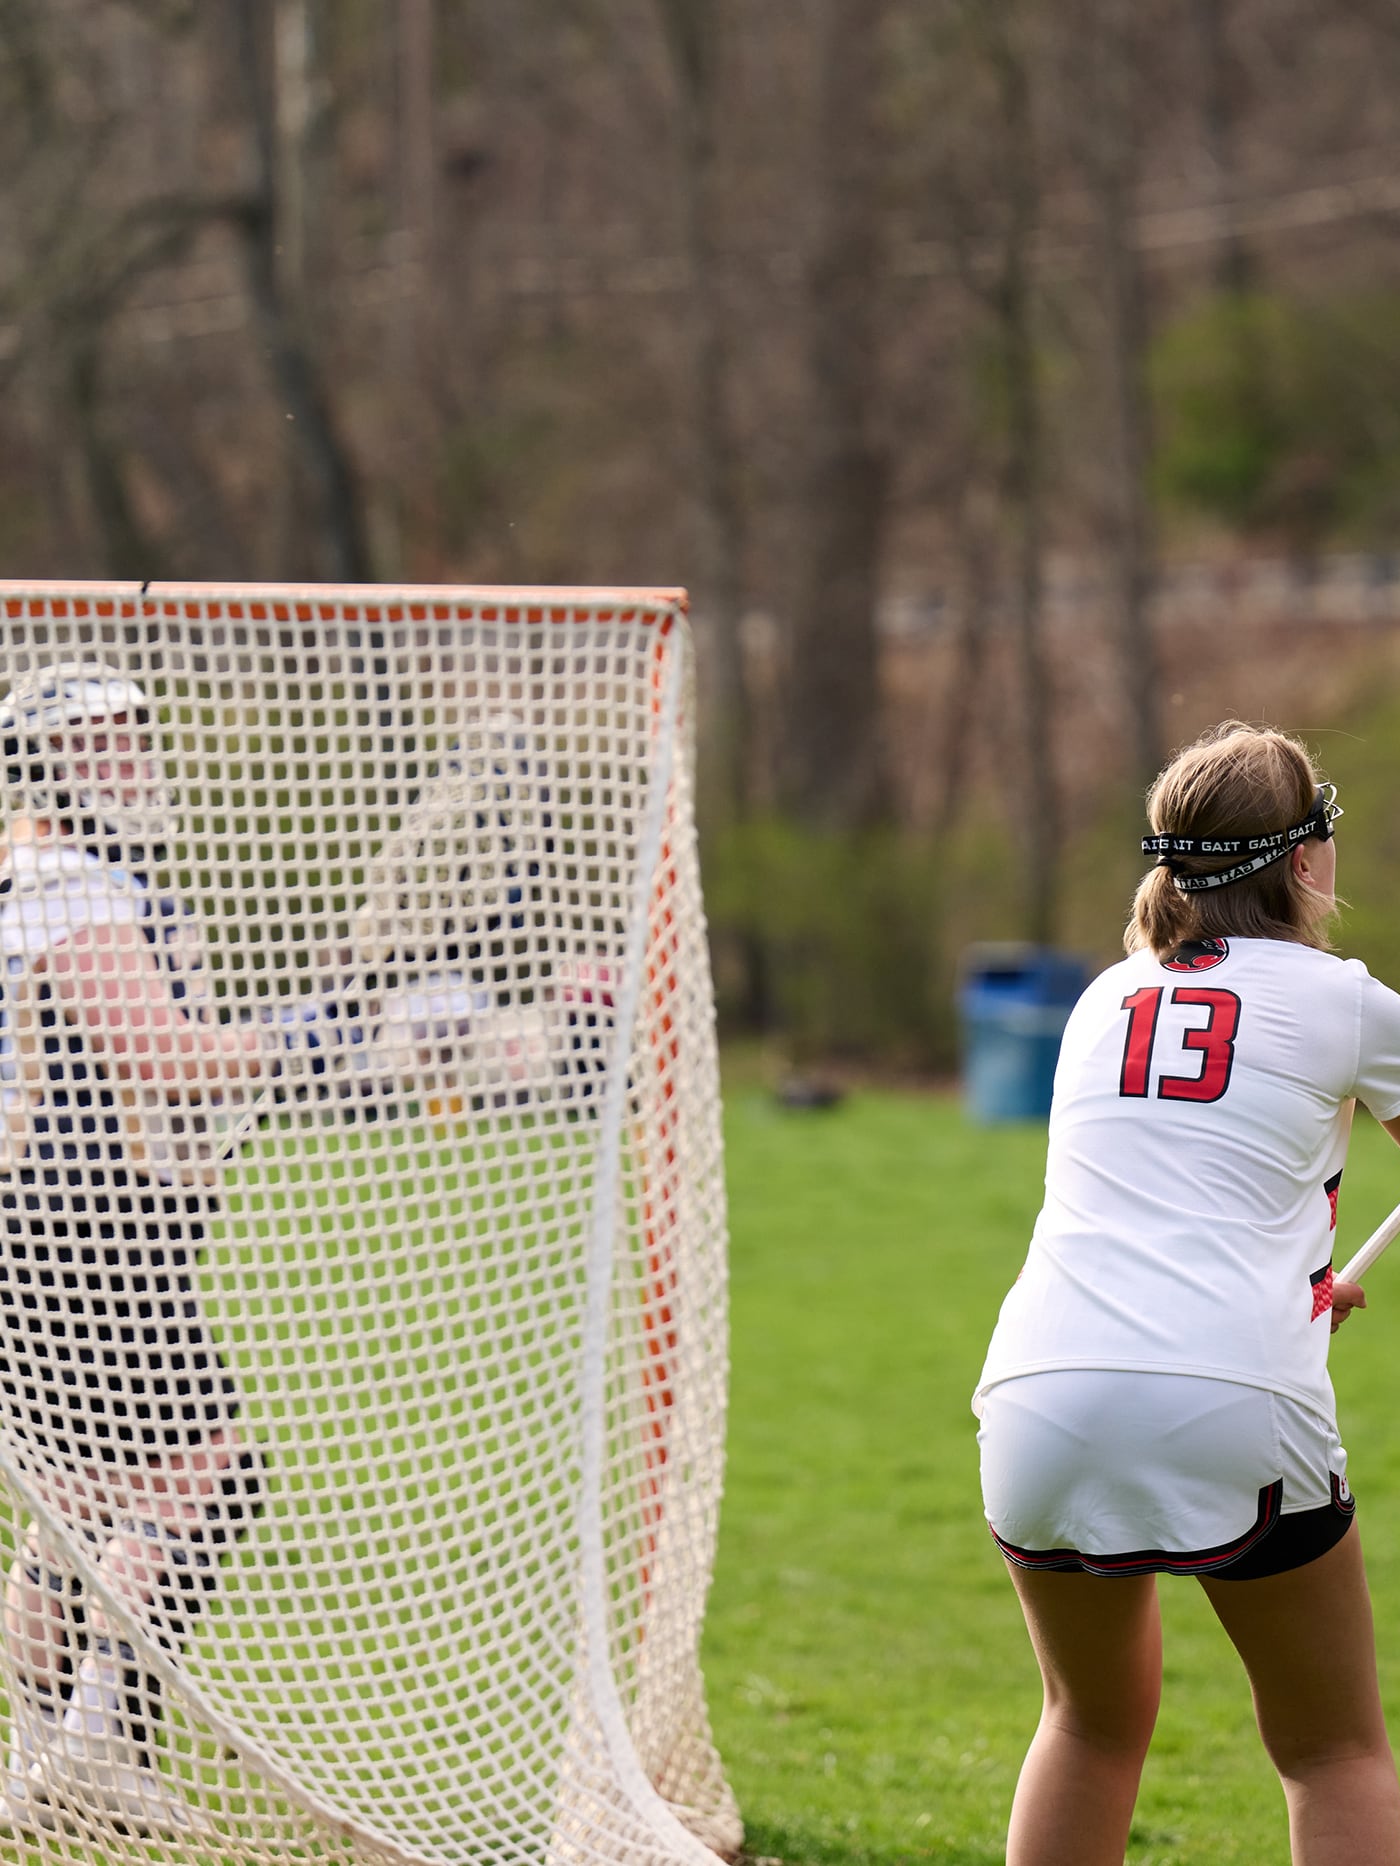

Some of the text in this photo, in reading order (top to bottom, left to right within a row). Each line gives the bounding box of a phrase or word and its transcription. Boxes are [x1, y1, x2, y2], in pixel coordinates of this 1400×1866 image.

[1201, 841, 1240, 852] GAIT
[1248, 834, 1283, 850] GAIT
[1288, 820, 1317, 840] GAIT
[1119, 986, 1242, 1104] 13
